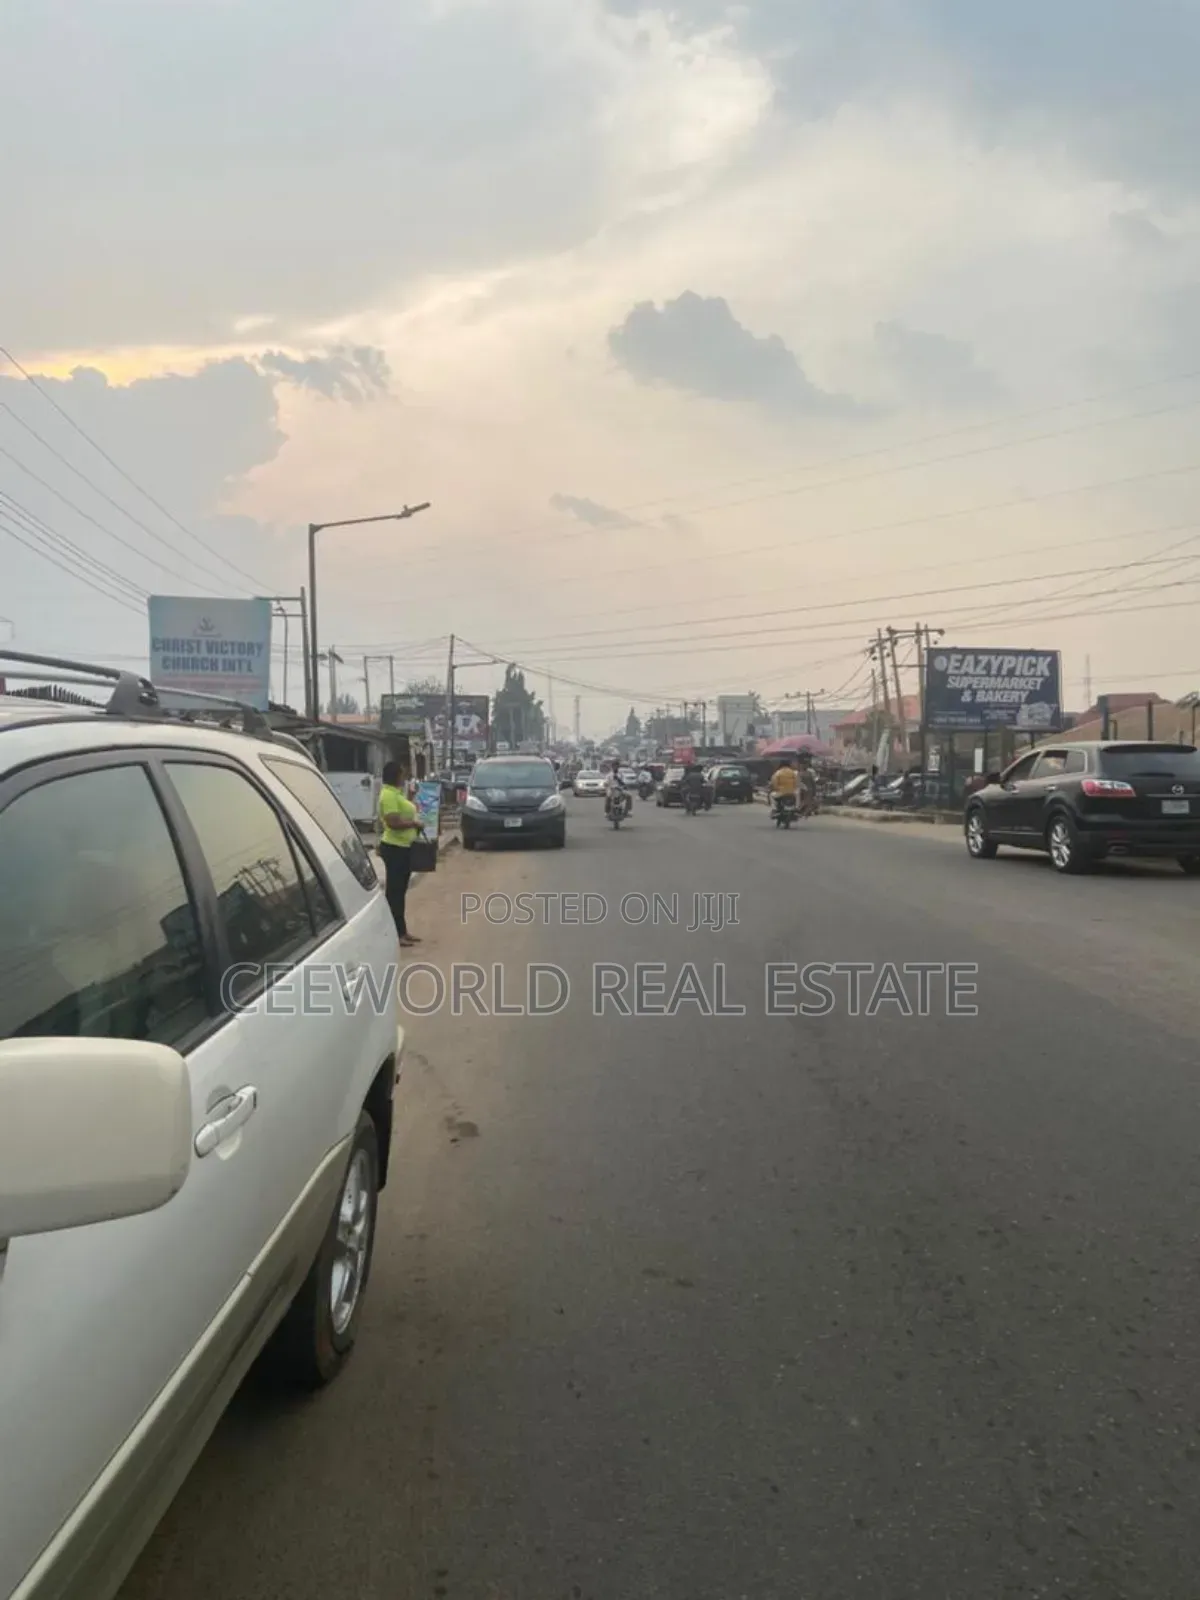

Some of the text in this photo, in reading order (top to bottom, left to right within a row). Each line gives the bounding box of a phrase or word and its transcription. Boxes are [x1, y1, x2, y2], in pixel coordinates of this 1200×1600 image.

[152, 637, 263, 657] CHRIST VICTORY
[161, 656, 219, 672] CHURCH
[946, 654, 1052, 677] EAZYPICK
[946, 676, 1044, 690] SUPERMARKET
[960, 690, 1030, 703] & BAKERY
